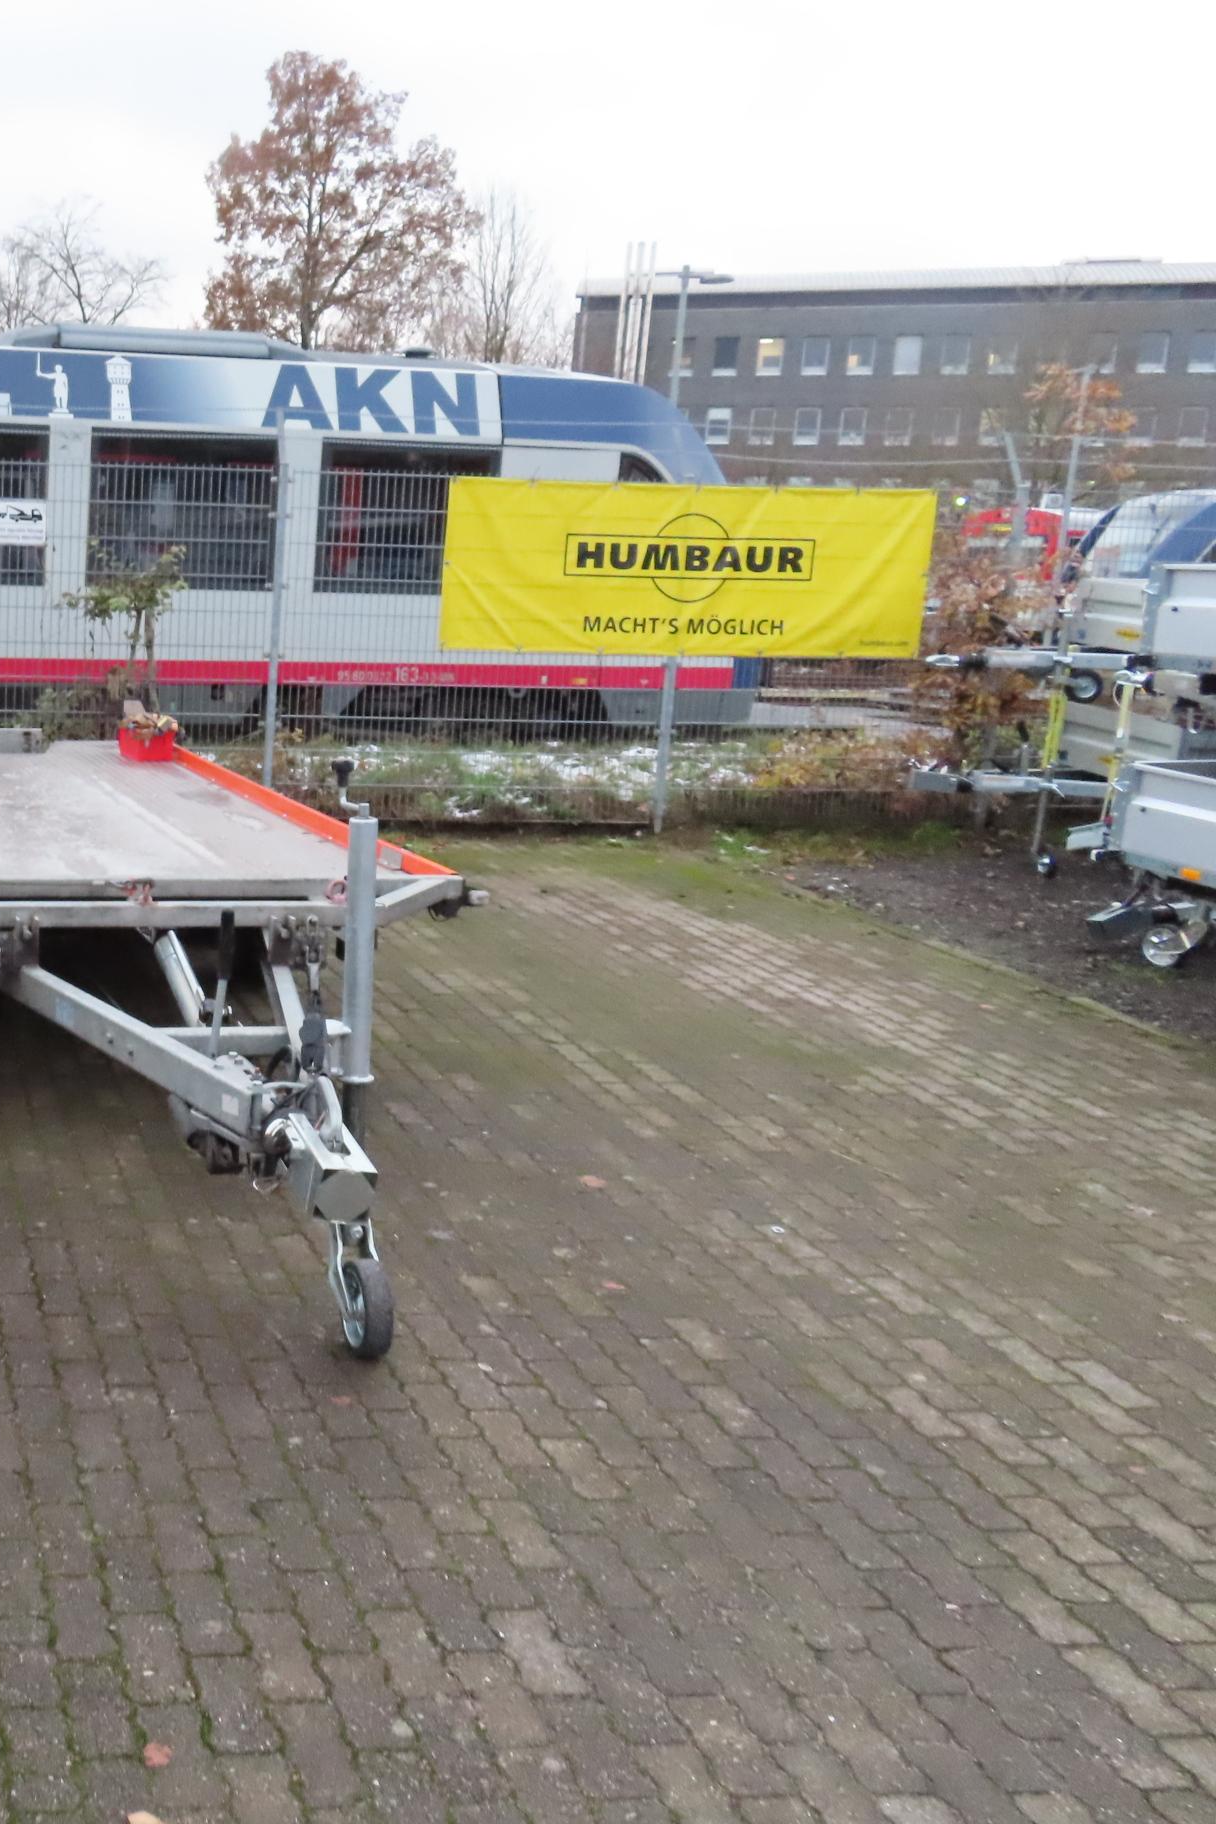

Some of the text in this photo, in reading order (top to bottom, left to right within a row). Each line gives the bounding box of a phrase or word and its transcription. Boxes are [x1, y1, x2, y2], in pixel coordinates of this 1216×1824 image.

[261, 364, 480, 436] AKN
[576, 541, 804, 573] HUMBAUR
[687, 614, 784, 636] MÖGLICH
